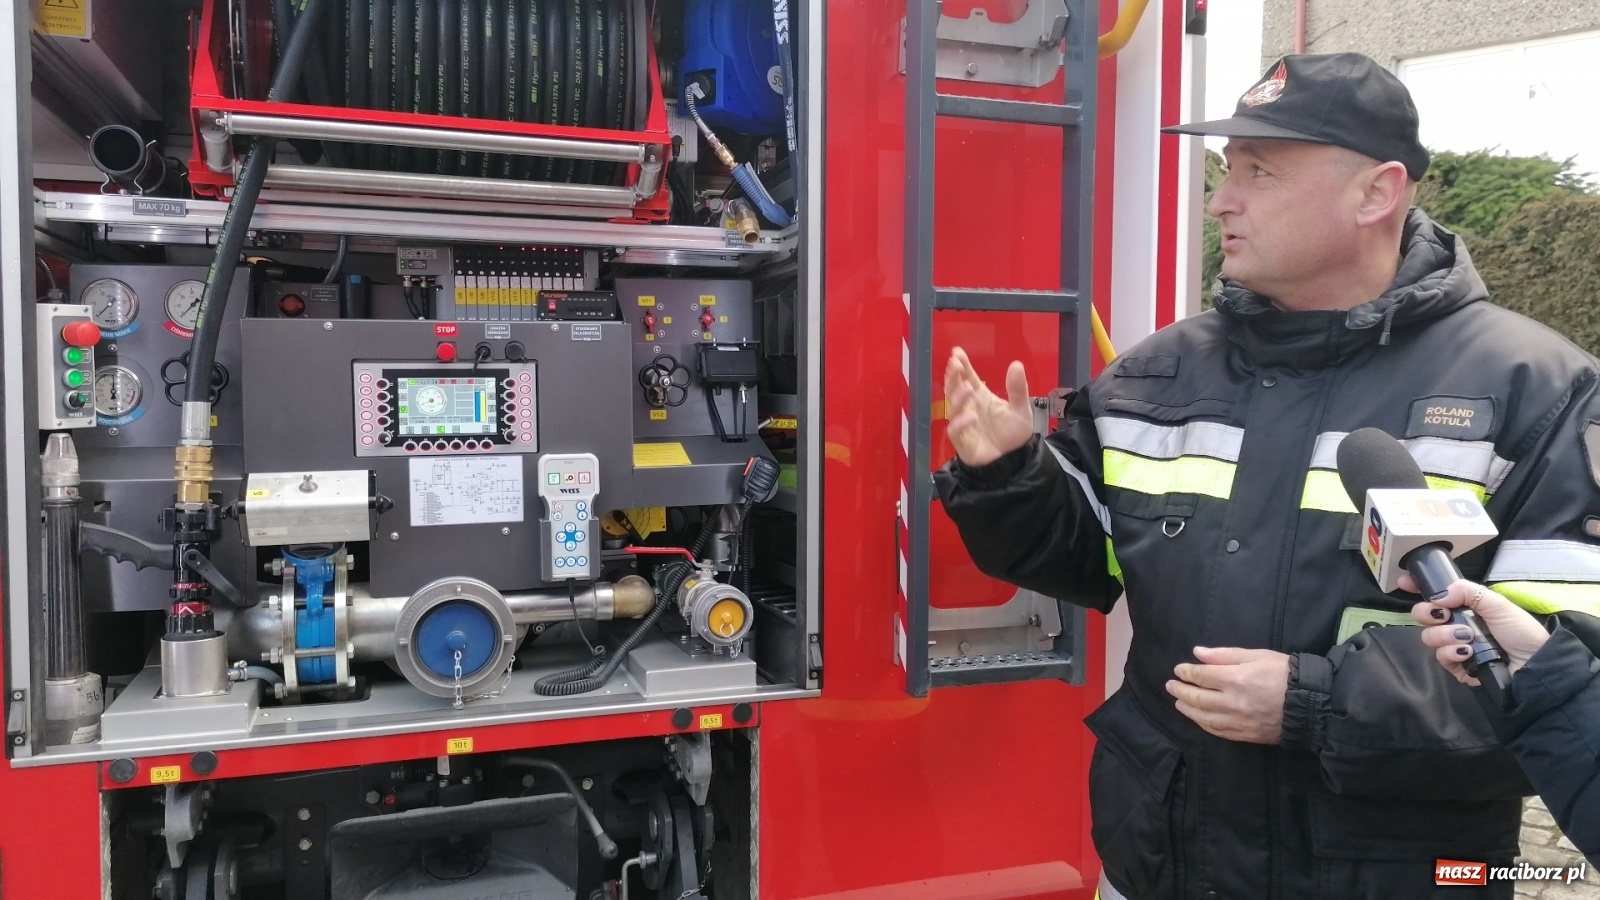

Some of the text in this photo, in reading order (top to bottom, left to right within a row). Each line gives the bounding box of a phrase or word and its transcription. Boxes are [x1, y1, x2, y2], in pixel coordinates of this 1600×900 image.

[138, 202, 158, 210] MAX
[171, 204, 180, 213] kg
[1426, 407, 1474, 417] ROLAND
[1424, 416, 1471, 427] KOTULA
